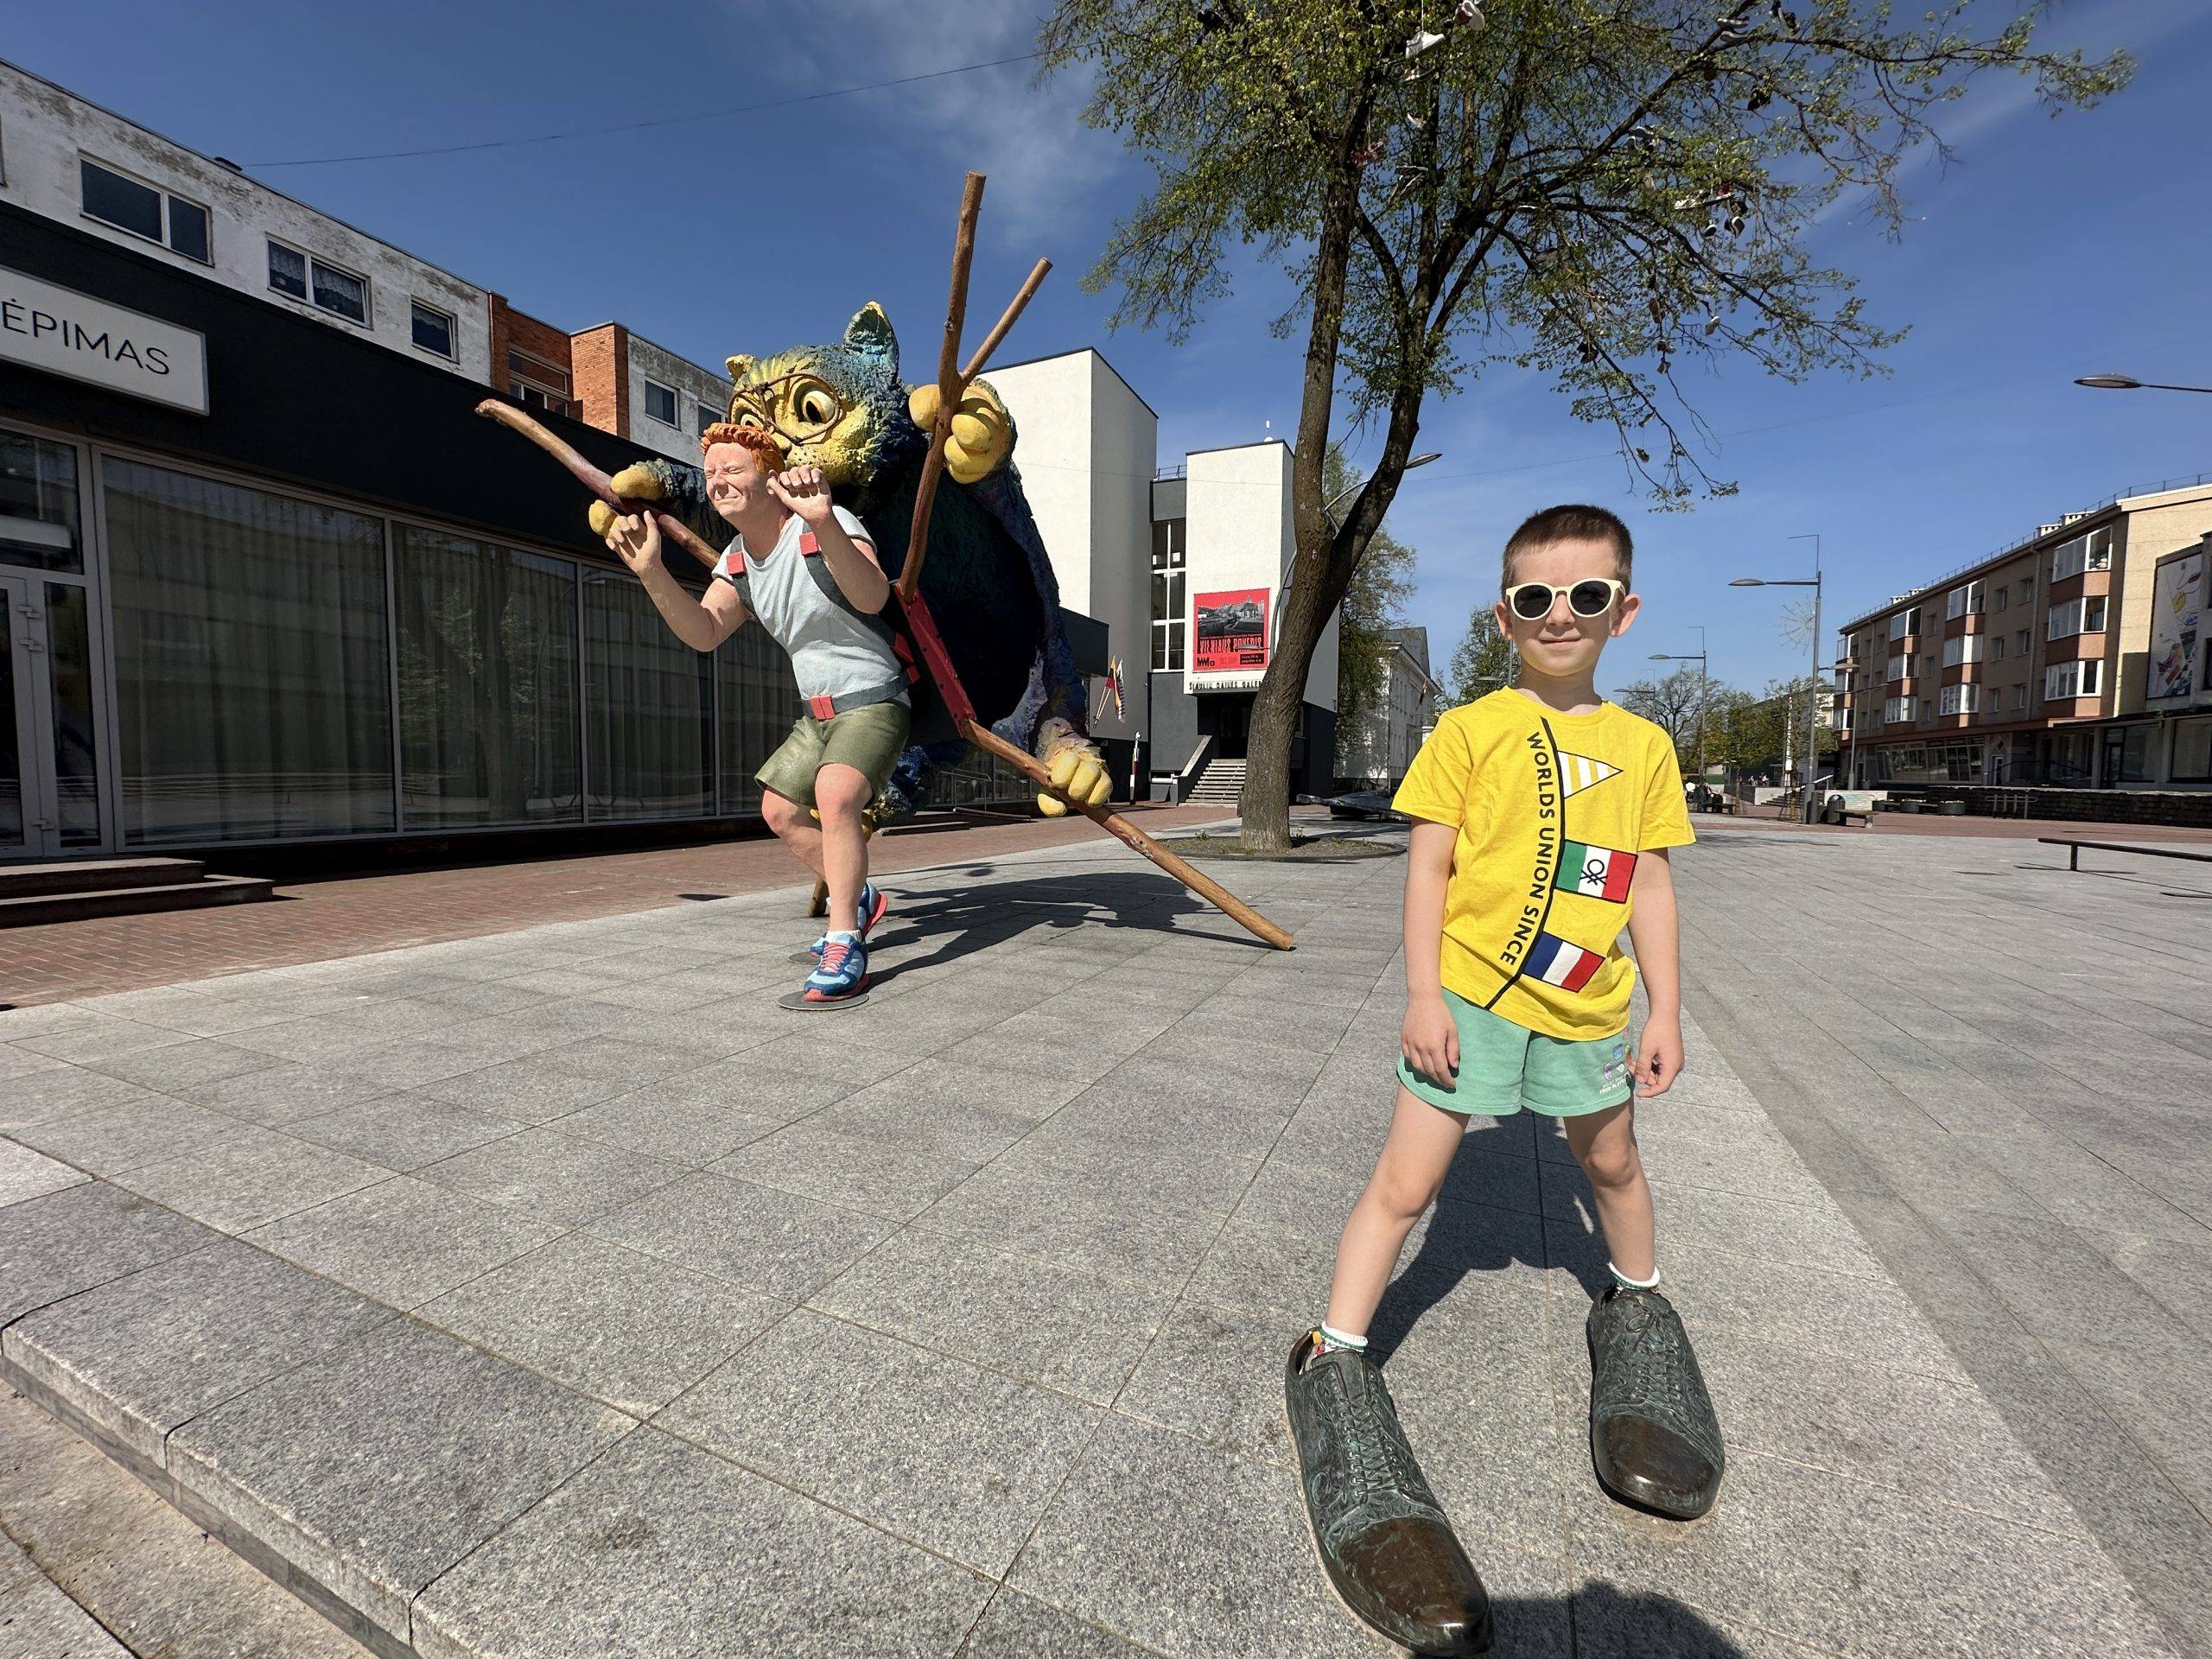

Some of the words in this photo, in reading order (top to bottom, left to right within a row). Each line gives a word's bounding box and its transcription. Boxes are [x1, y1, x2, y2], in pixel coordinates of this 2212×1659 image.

[2, 298, 169, 375] ĖPIMAS
[1527, 732, 1554, 819] WORLDS
[1532, 827, 1554, 899] UNION
[1501, 906, 1539, 966] SINCE
